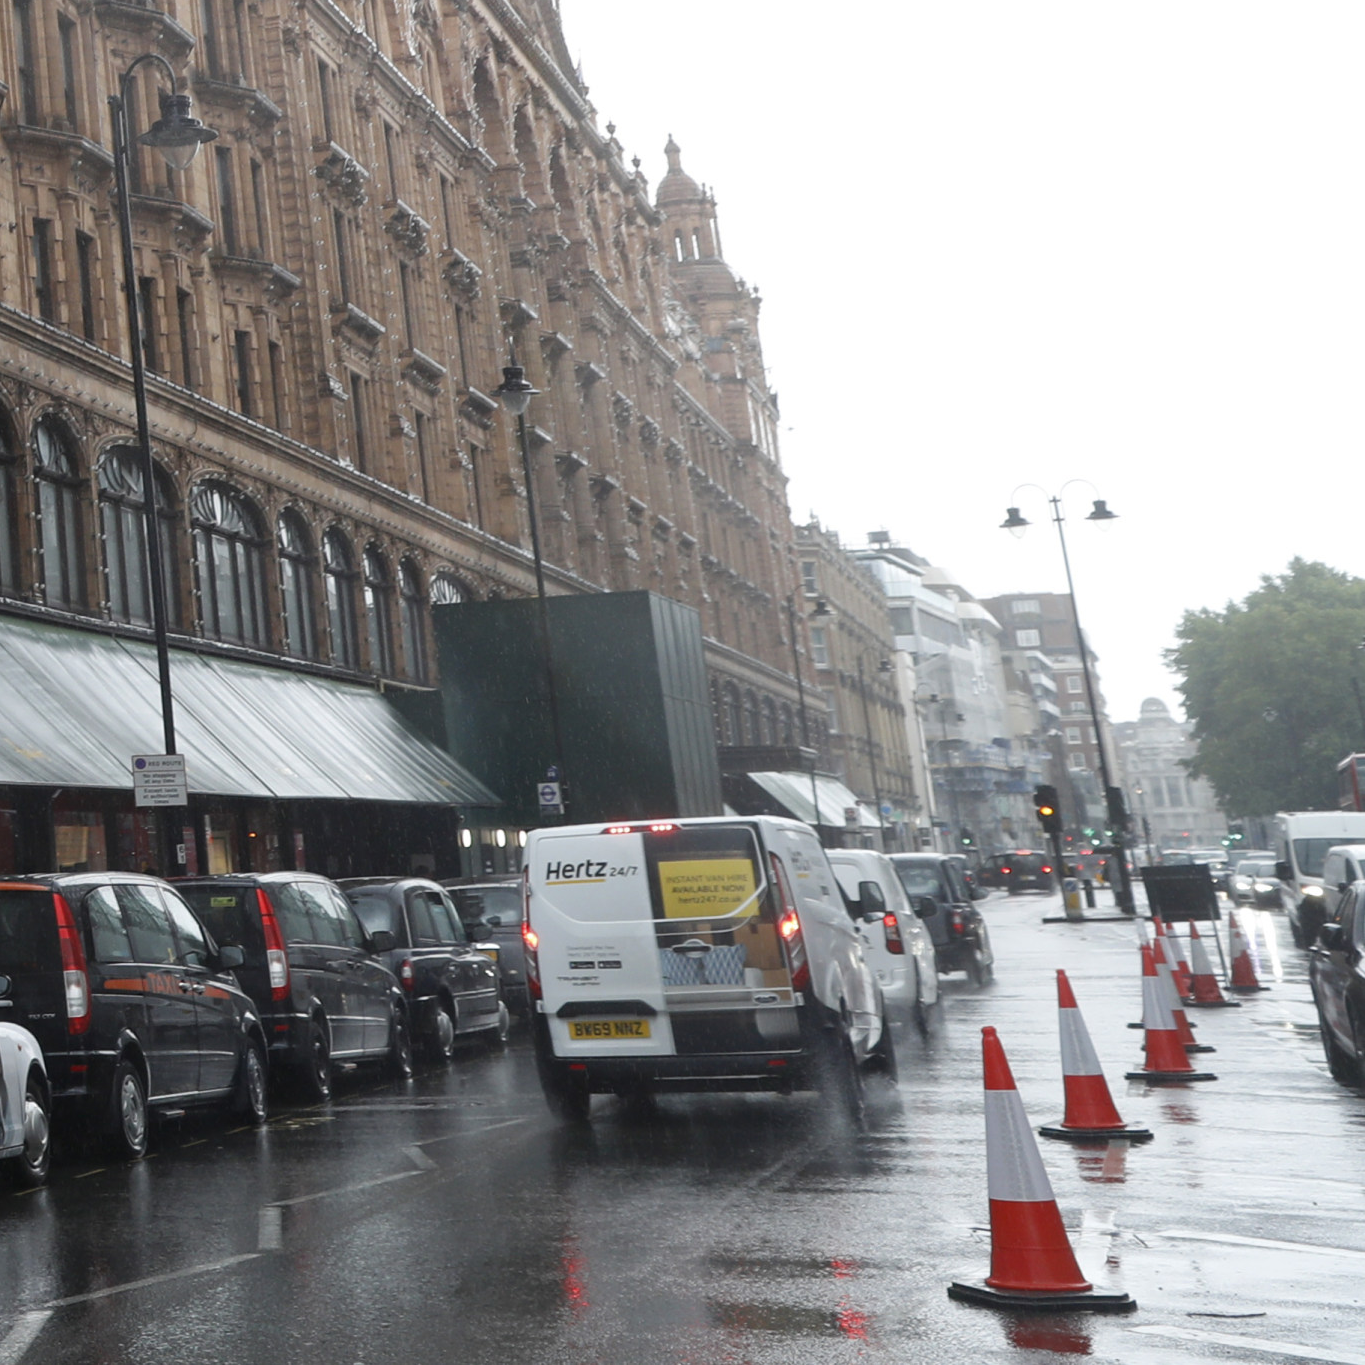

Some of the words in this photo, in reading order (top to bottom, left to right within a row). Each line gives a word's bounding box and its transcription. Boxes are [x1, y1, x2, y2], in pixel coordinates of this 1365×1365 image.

[546, 859, 608, 880] Hertz
[665, 874, 702, 884] INSTANT
[704, 874, 725, 882] VAN
[726, 873, 749, 881] HIRE
[671, 885, 719, 894] AVAILABLE
[721, 884, 746, 893] NOW
[148, 973, 179, 995] TAXI
[614, 1022, 644, 1036] NNZ
